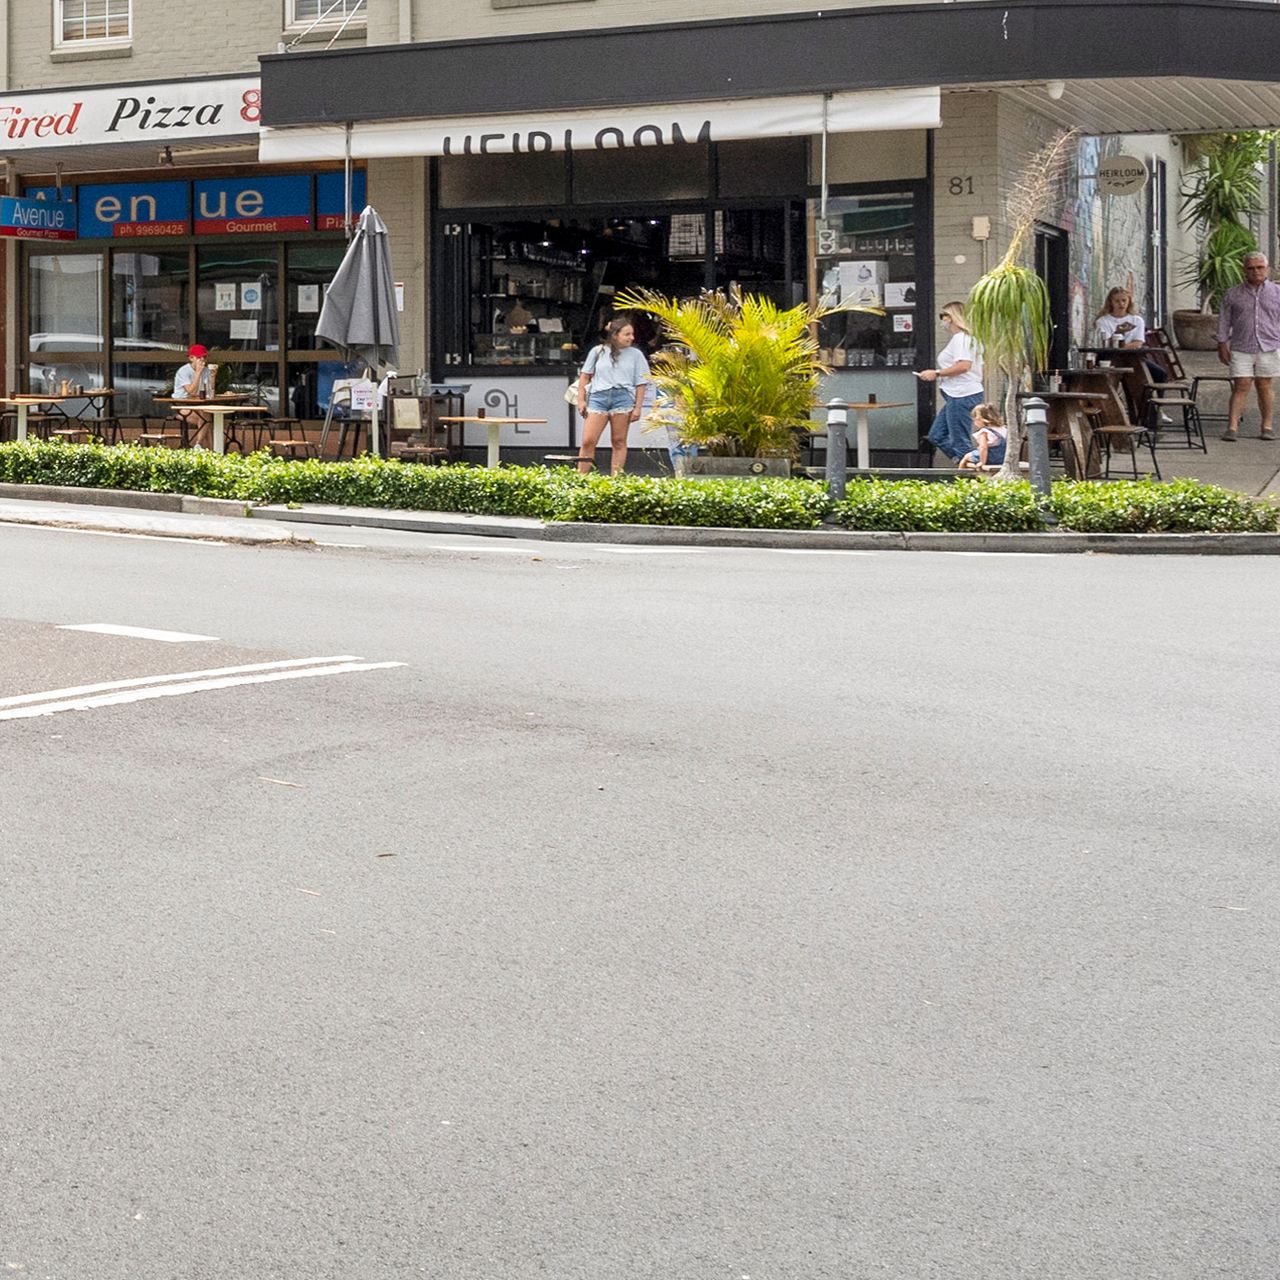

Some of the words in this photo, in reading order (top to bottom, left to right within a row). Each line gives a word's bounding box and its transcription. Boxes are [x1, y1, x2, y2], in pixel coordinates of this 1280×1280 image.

[105, 97, 224, 132] Pizza
[1099, 169, 1144, 177] HEIRLOOM
[948, 175, 975, 196] 81
[12, 202, 65, 228] Avenue
[136, 224, 184, 236] 99690425
[226, 221, 278, 233] Gourmet
